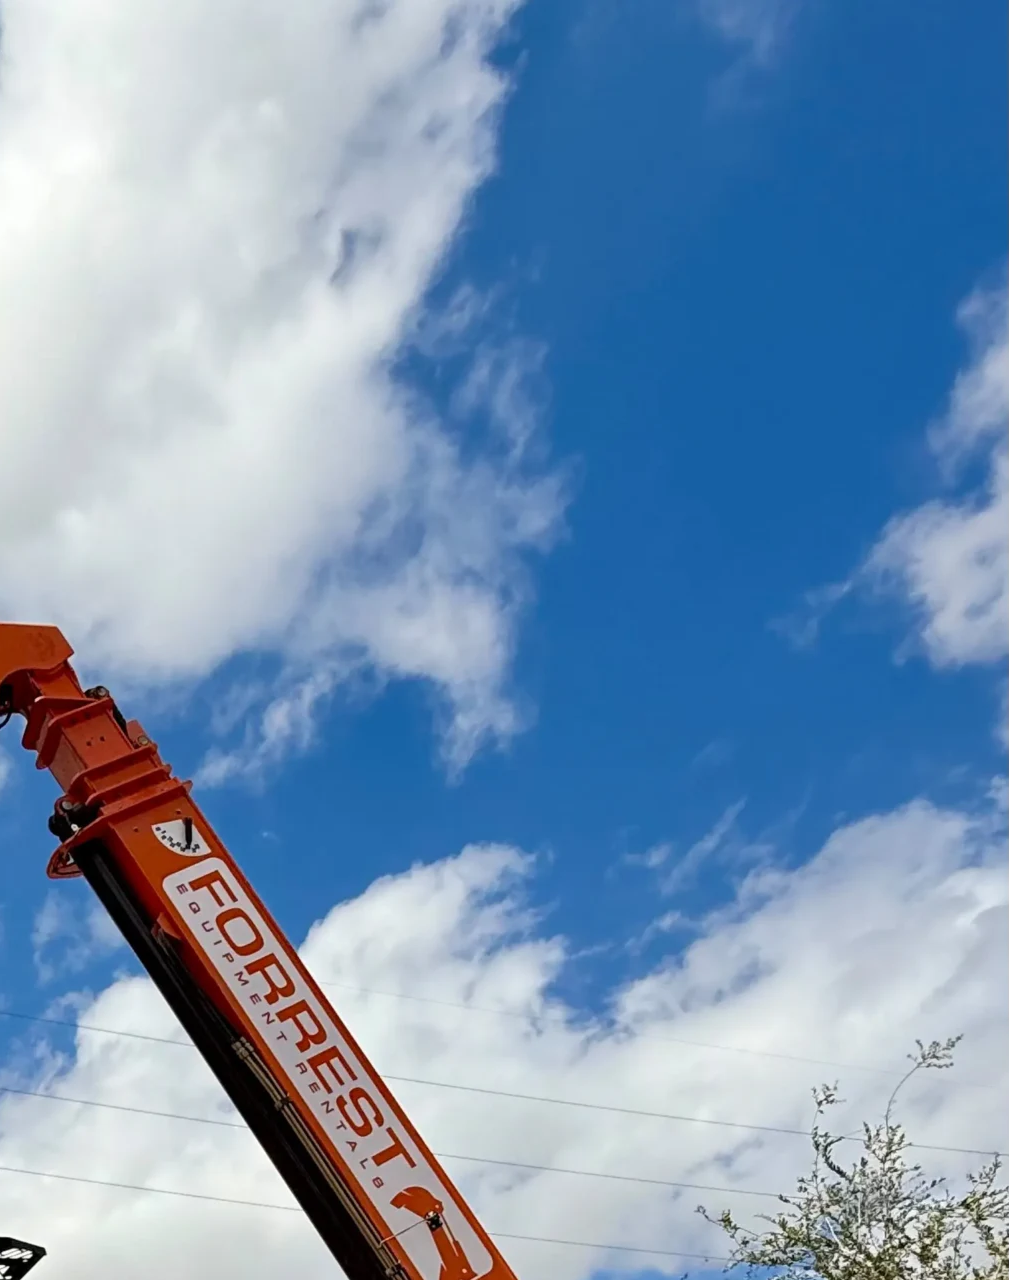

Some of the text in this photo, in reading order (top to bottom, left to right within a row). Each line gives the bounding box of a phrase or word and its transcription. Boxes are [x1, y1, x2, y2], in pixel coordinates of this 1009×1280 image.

[176, 883, 288, 1042] EQUIPMENT
[295, 1062, 384, 1189] RENTALS
[188, 870, 417, 1168] FORREST
